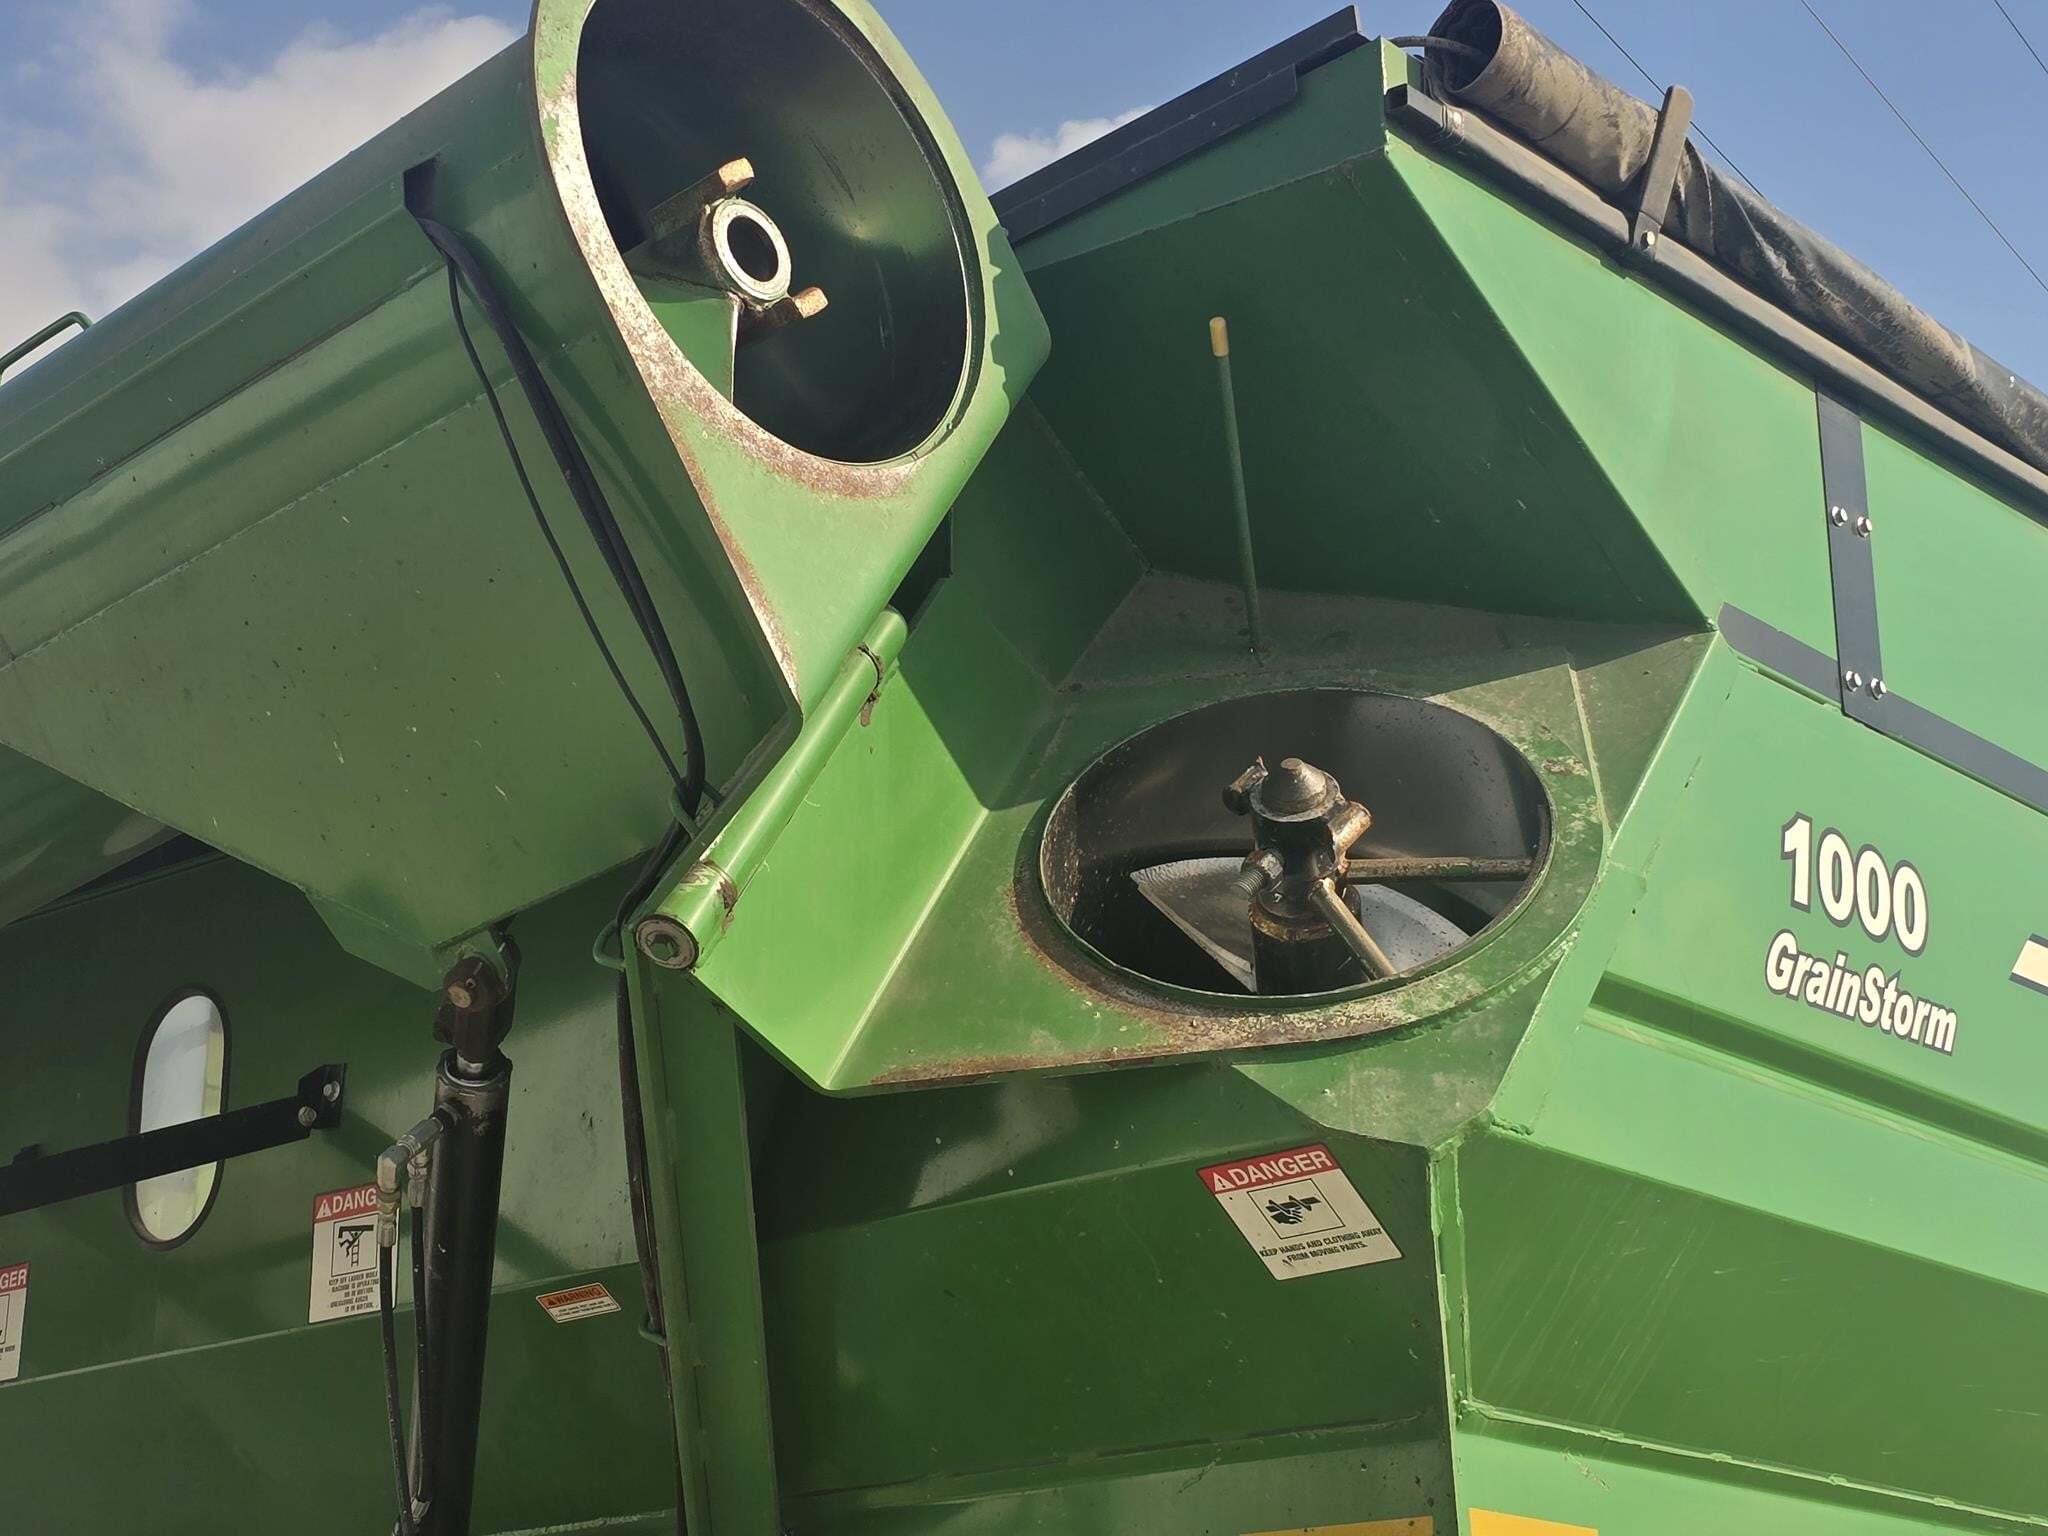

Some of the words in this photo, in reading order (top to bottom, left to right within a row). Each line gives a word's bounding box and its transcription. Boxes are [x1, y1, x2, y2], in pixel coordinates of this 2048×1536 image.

[1781, 811, 1928, 957] 1000
[1765, 928, 1957, 1056] GrainStorm
[1229, 1150, 1333, 1186] DANGER
[333, 1188, 377, 1213] DANG
[1260, 1247, 1279, 1257] KEEP
[1280, 1243, 1305, 1254] HANDS
[1306, 1239, 1323, 1249] AND
[1323, 1231, 1361, 1245] CLOTHING
[1361, 1227, 1382, 1238] AWAY
[1287, 1252, 1310, 1262] FROM
[1309, 1247, 1340, 1258] MOVING
[0, 1269, 27, 1290] GER
